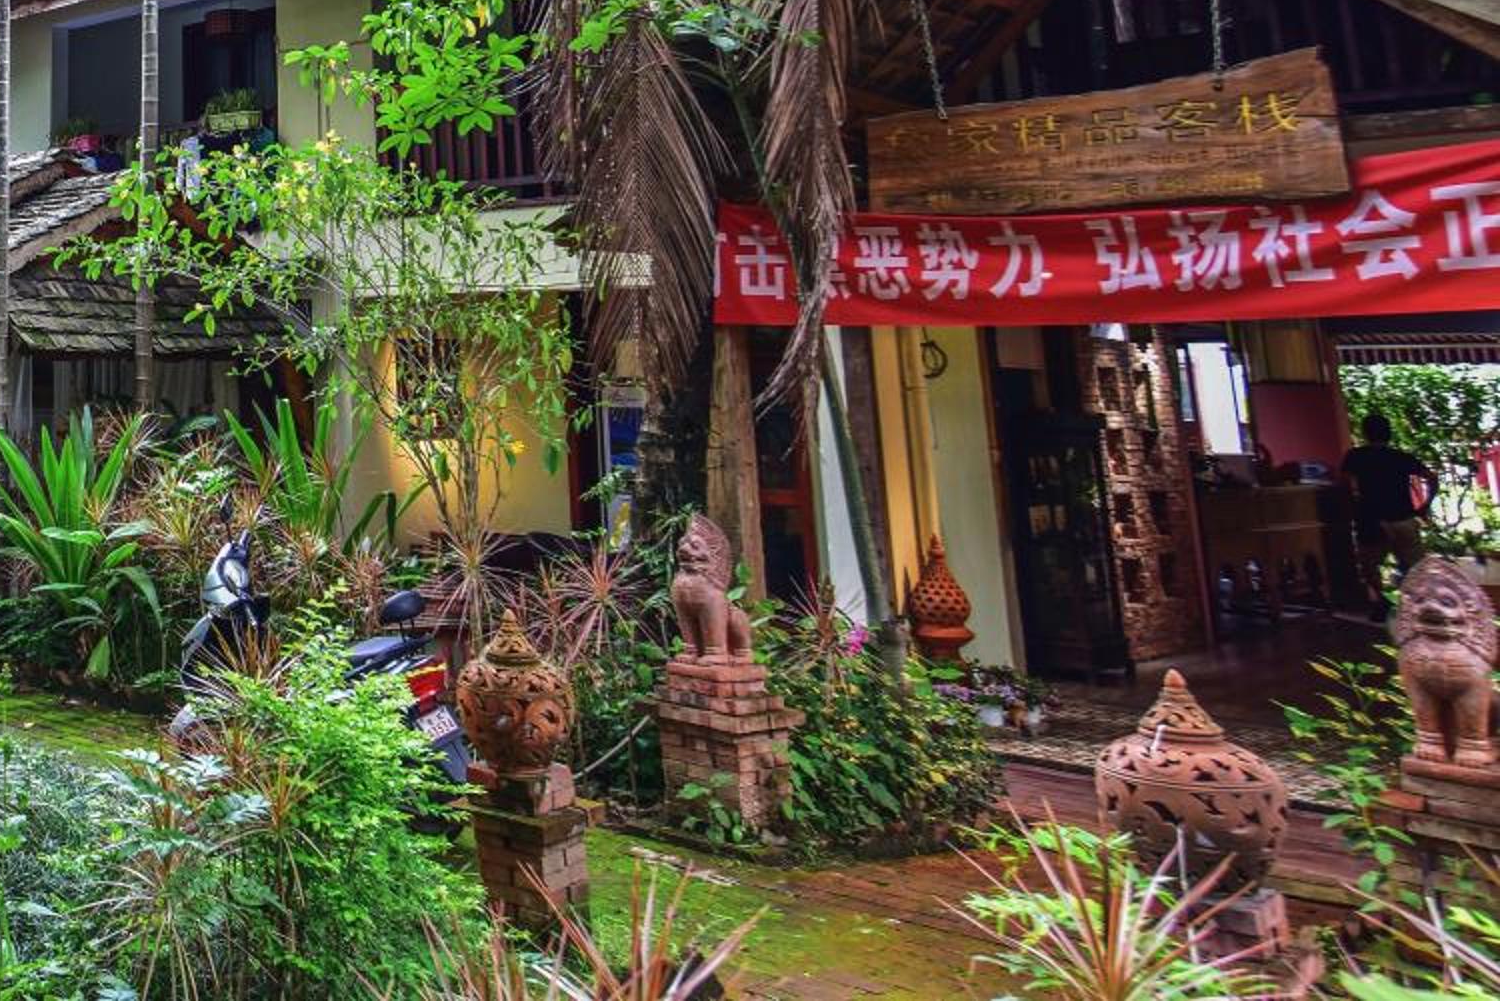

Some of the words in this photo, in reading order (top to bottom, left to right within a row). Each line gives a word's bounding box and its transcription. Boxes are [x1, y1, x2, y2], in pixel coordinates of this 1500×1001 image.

[713, 220, 1047, 301] 击恶势力
[1086, 180, 1500, 295] 弘扬社会正
